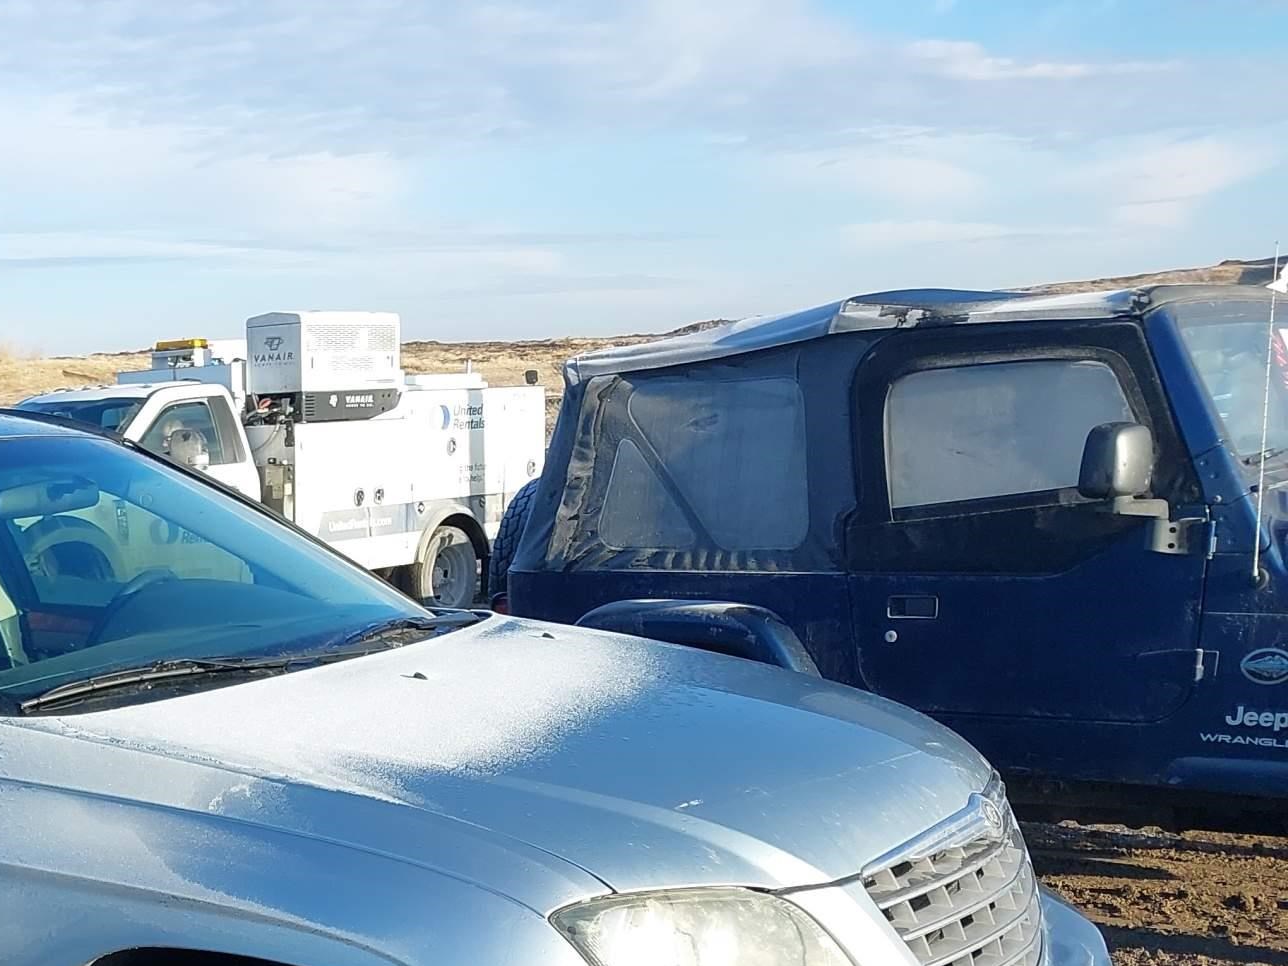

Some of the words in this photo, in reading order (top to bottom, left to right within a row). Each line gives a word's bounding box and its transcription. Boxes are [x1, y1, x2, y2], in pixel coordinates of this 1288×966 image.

[254, 352, 294, 362] VANAIR
[453, 404, 483, 416] United
[453, 418, 485, 430] Rentals
[1225, 705, 1288, 731] Jeep
[1200, 732, 1288, 748] WRANGL
